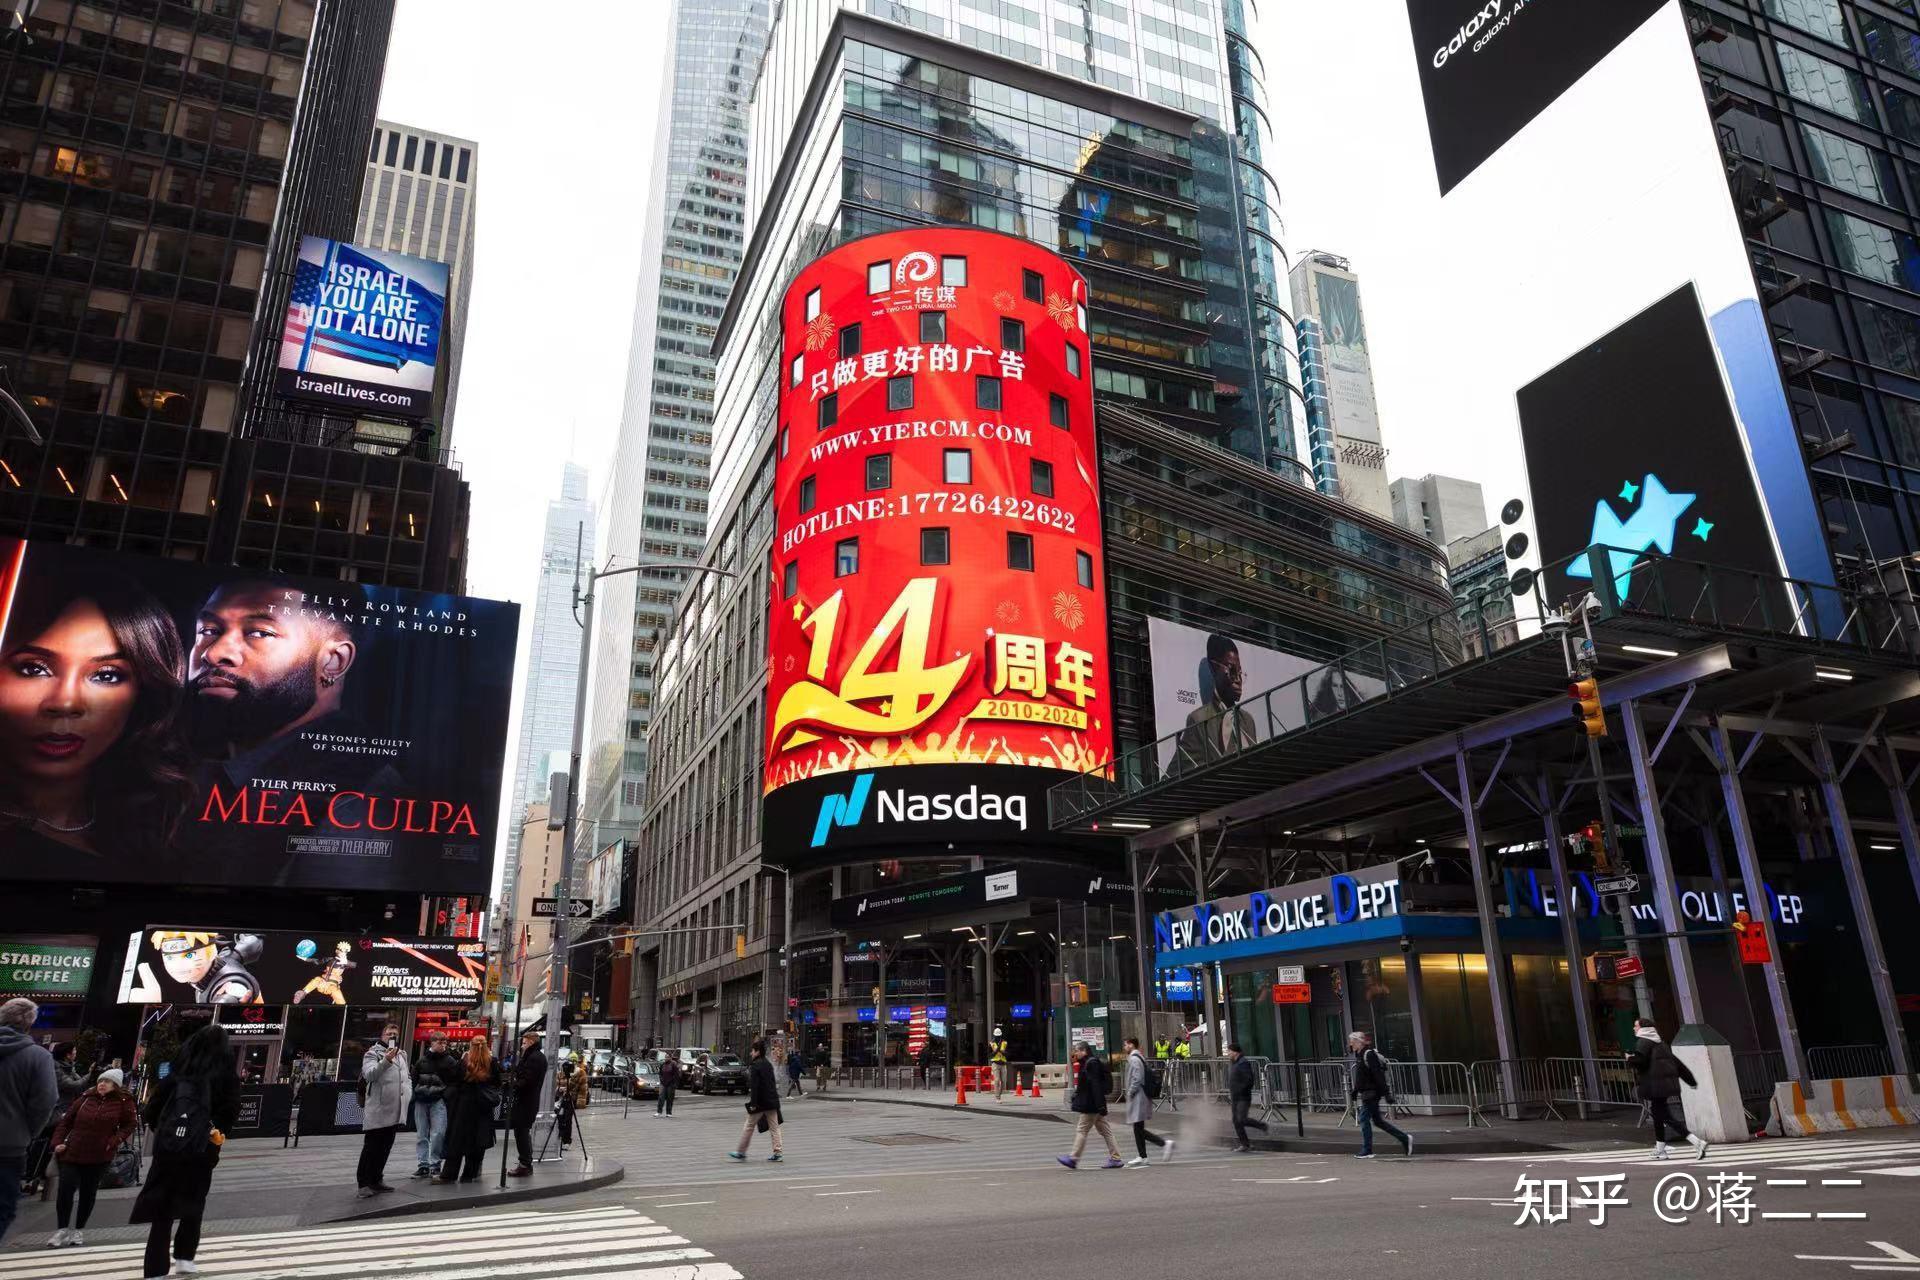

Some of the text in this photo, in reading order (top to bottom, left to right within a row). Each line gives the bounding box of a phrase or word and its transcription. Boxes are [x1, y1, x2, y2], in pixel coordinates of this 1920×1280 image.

[1433, 0, 1501, 68] Galaxy
[1473, 11, 1511, 53] Galaxy
[328, 262, 412, 298] ISRAEL
[872, 286, 957, 305] 一二传媒
[319, 282, 419, 322] YOU ARE
[298, 302, 430, 347] NOT ALONE
[810, 343, 1026, 402] 只做更好的广告
[295, 376, 412, 407] IsraelLives.com
[810, 420, 1033, 463] WWW.YIERCM.COM
[782, 492, 1076, 553] HOTLINE:17726422622
[268, 604, 478, 637] TREVANTE RHODES
[284, 591, 467, 622] KELLY ROWLAND
[776, 577, 972, 738] 14
[994, 632, 1097, 707] 周年
[987, 700, 1080, 726] 2010-2024
[301, 732, 412, 748] EVERYONE'S GUILTY
[312, 743, 398, 756] OF SOMETHING
[252, 778, 337, 792] TYLER PERRY'S
[198, 783, 481, 836] MEA CULPA
[877, 785, 1028, 832] Nasdaq
[341, 839, 390, 855] TYLER PERRY
[1617, 880, 1632, 888] WAY
[540, 903, 557, 912] ONE
[1153, 874, 1399, 951] NEW YORK POLICE DEPT
[0, 952, 91, 968] STARBUCKS
[13, 968, 70, 983] COFFEE
[371, 976, 480, 989] NARUTO UZUMAKI
